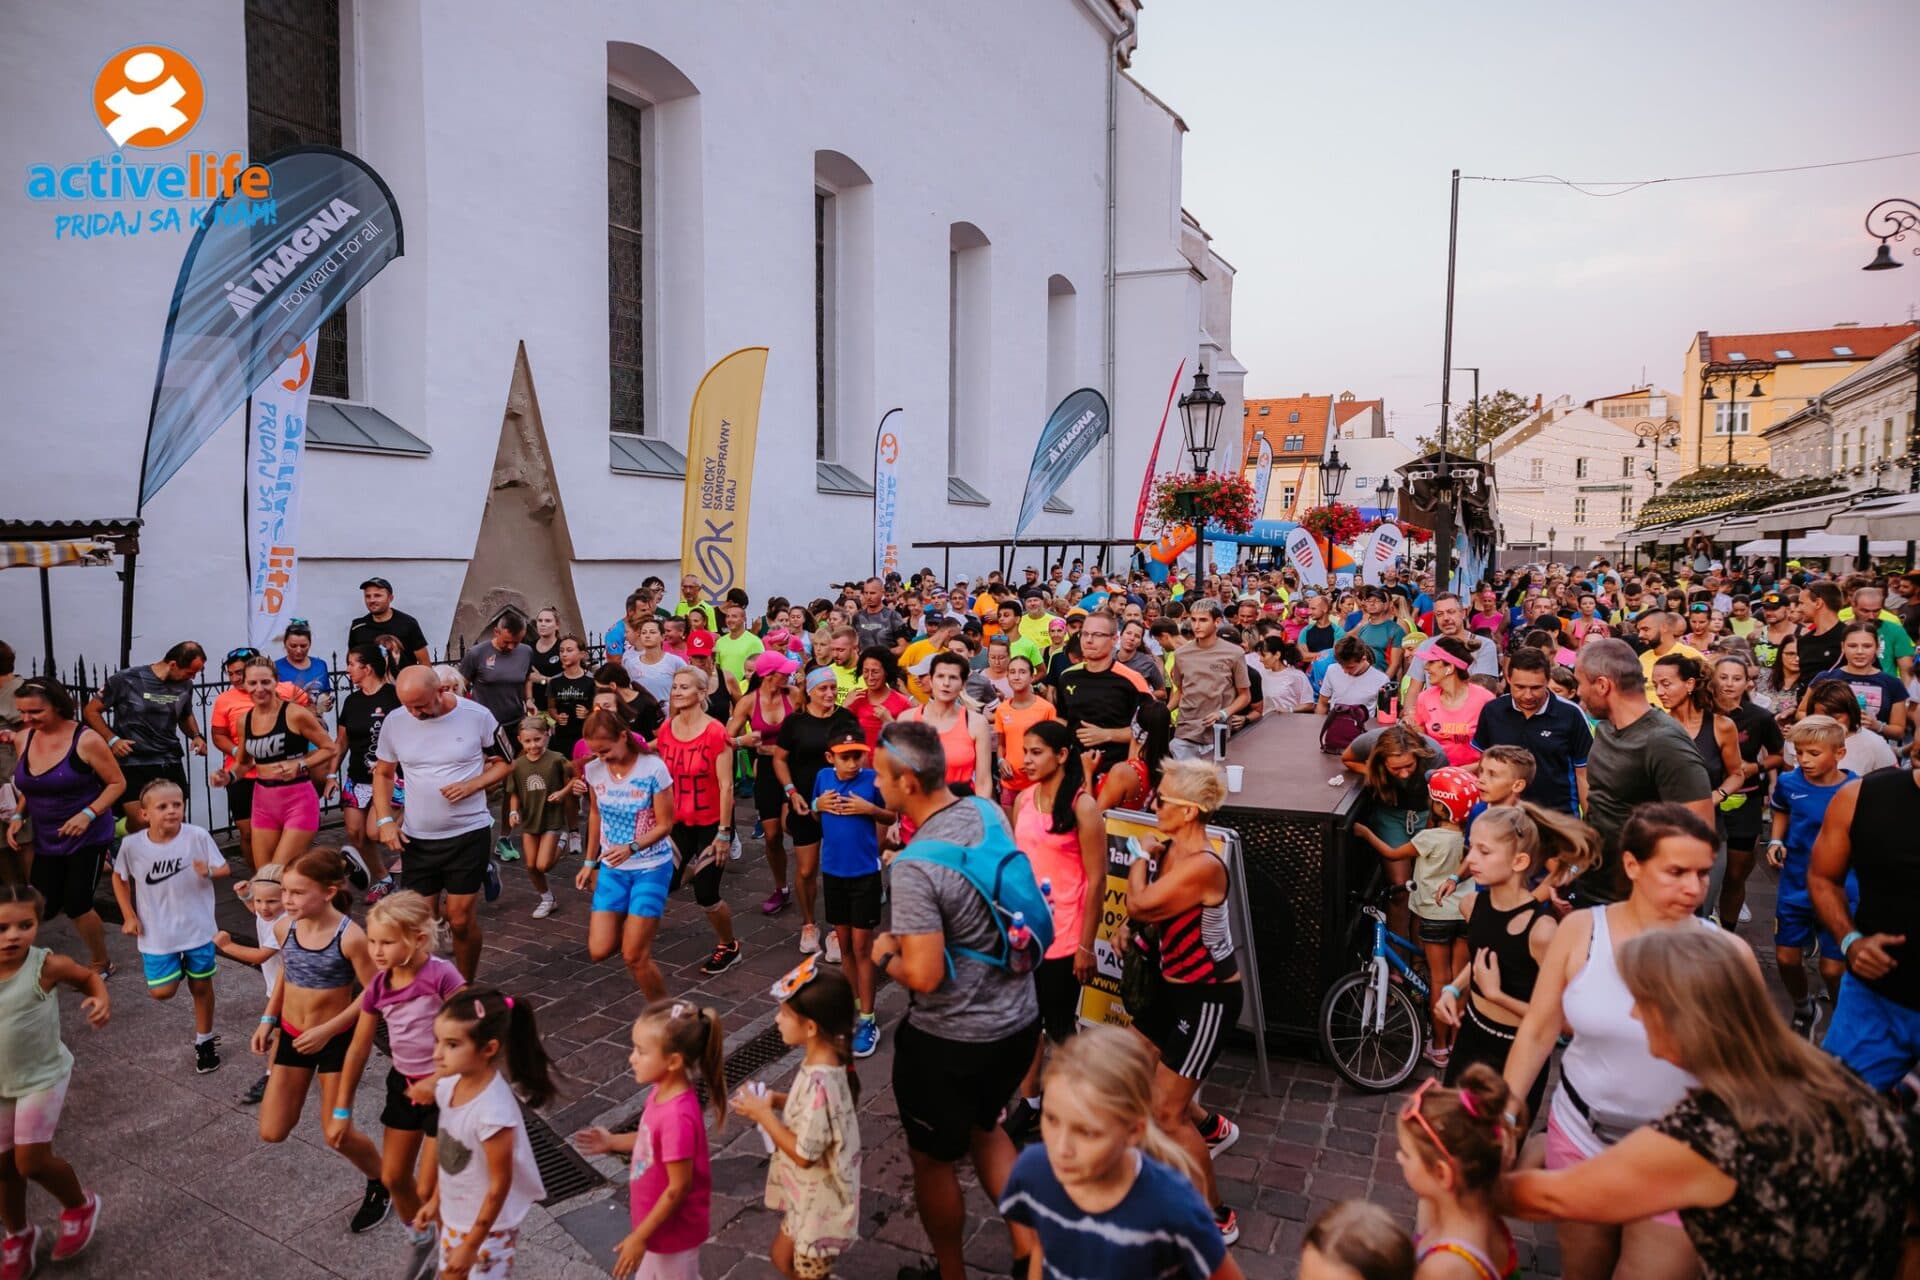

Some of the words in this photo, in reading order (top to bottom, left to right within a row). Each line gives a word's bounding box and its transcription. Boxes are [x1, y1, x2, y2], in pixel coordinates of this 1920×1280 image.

[251, 198, 361, 292] MAGNA
[279, 257, 342, 312] Forward.
[335, 242, 363, 261] For
[361, 220, 383, 242] all.
[257, 401, 276, 479] PRIDAJ
[1057, 409, 1096, 452] MAGNA
[702, 456, 717, 510] KOŠICKÝ
[714, 419, 731, 511] SAMOSPRÁVNY
[257, 484, 275, 512] SA
[725, 479, 737, 512] KRAJ
[1439, 489, 1452, 503] 10
[246, 733, 286, 758] NIKE
[1431, 787, 1459, 800] woom
[151, 857, 183, 875] NIKE
